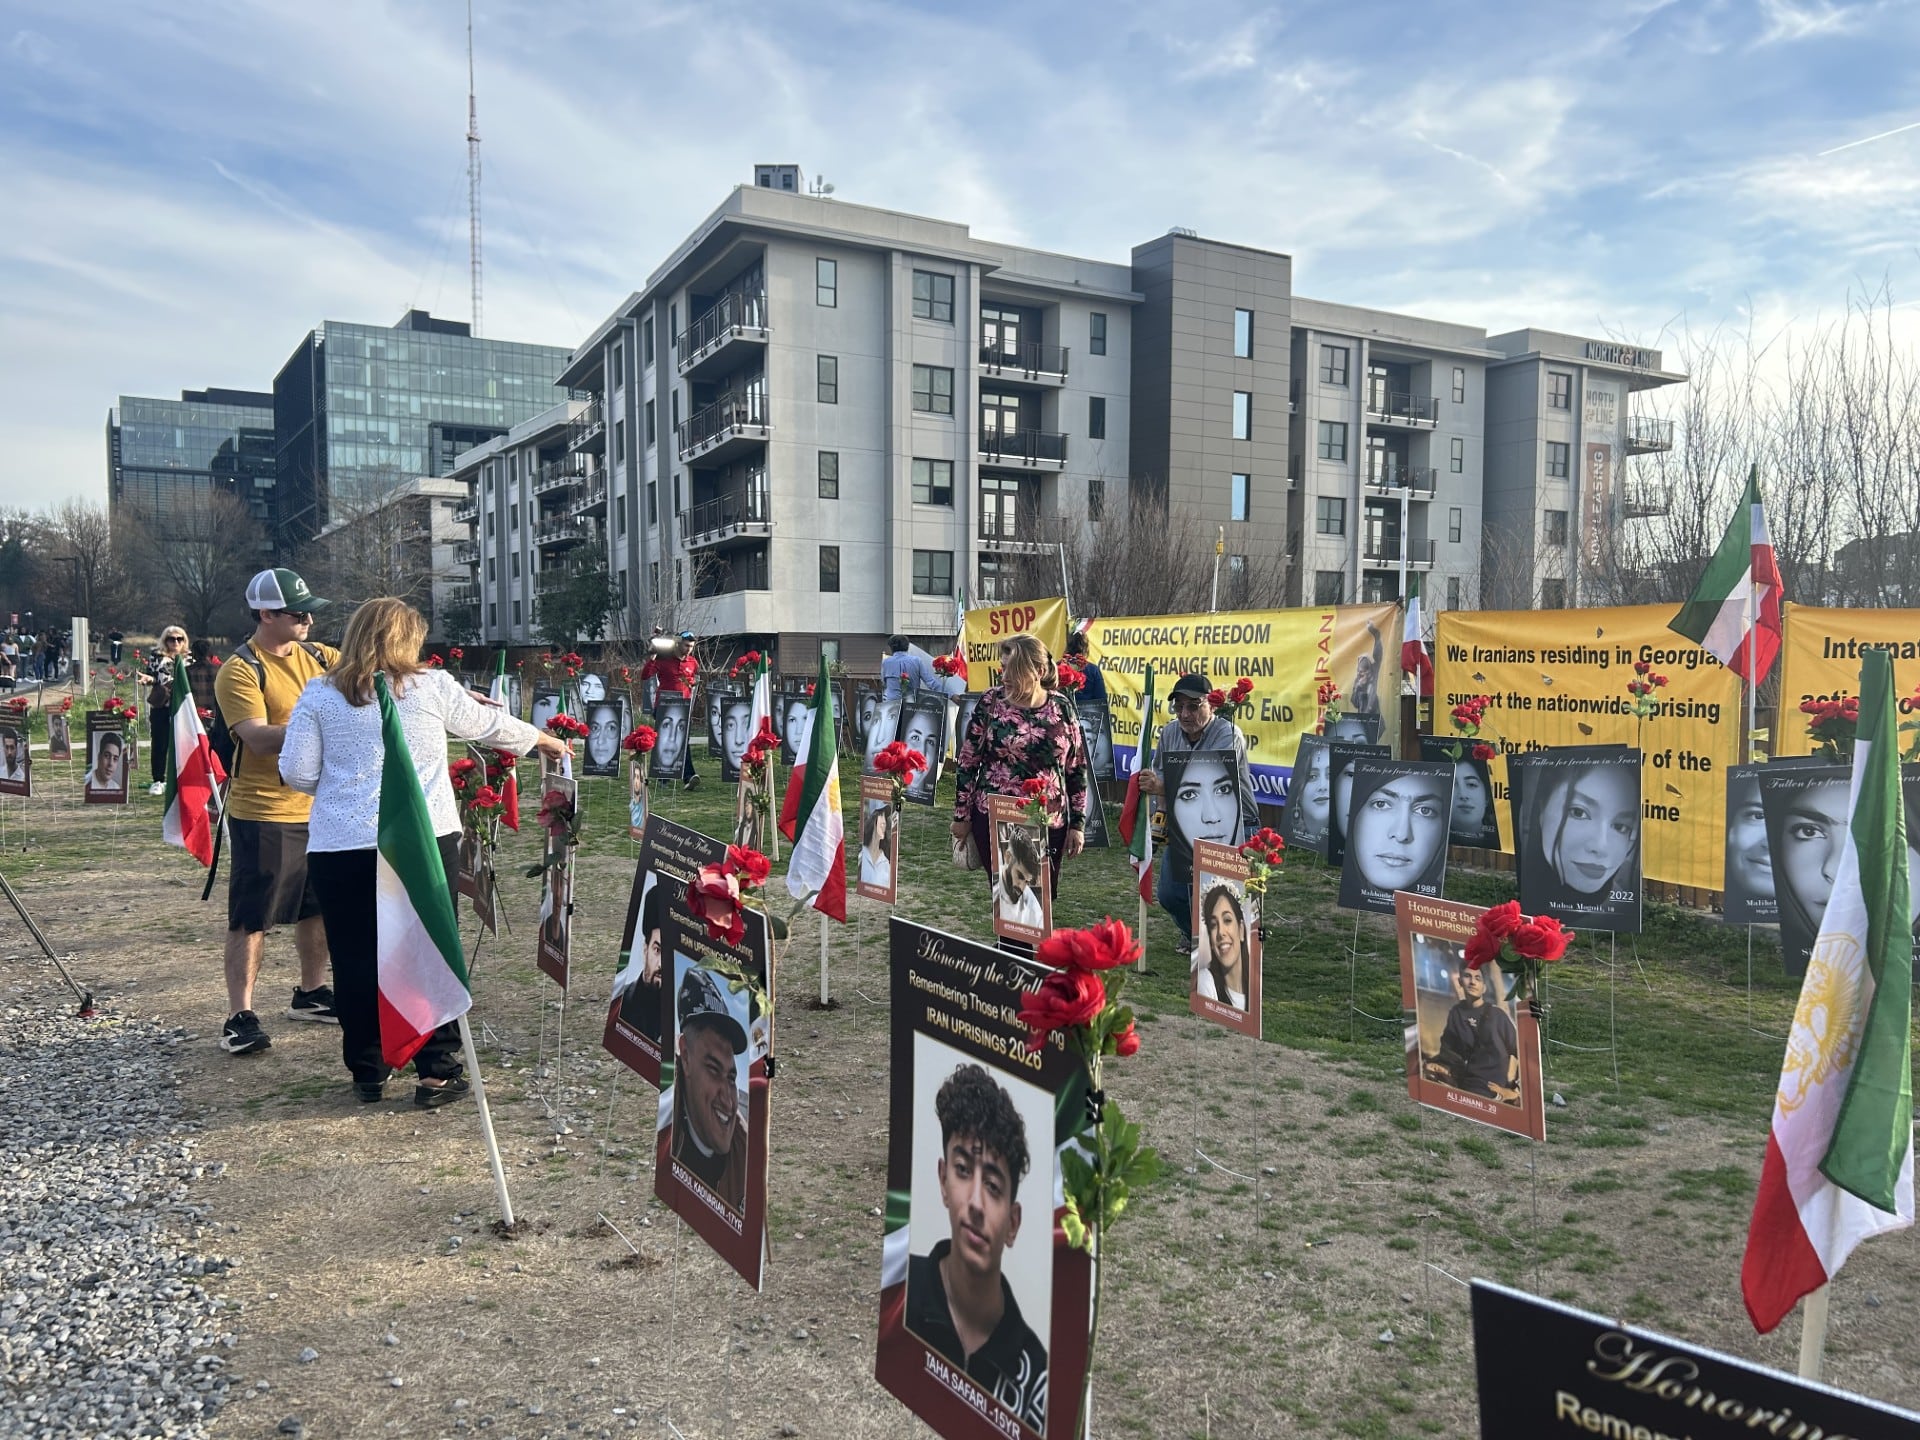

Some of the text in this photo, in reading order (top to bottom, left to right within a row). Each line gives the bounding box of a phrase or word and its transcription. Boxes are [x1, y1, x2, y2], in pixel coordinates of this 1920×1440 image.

[1588, 341, 1620, 364] NORTH
[1586, 389, 1614, 408] NORTH
[1595, 408, 1614, 425] LINE
[989, 606, 1036, 634] STOP
[1102, 623, 1271, 648] DEMOCRACY, FREEDOM
[1314, 614, 1335, 681] IRAN
[1447, 644, 1468, 662] We
[1473, 645, 1535, 663] Iranians
[1541, 643, 1609, 669] residing
[1616, 645, 1632, 664] in
[1153, 656, 1208, 676] CHANGE
[1213, 657, 1229, 676] IN
[1234, 656, 1274, 677] IRAN
[1261, 698, 1293, 722] END
[1507, 691, 1532, 710] the
[1537, 693, 1631, 714] nationwide
[1648, 697, 1720, 721] prising
[1500, 737, 1521, 753] for
[1527, 756, 1554, 767] Fallen
[1555, 758, 1567, 767] for
[1567, 756, 1600, 767] freedom
[1613, 753, 1637, 765] Iran
[1653, 751, 1671, 769] of
[1678, 751, 1712, 771] the
[1359, 765, 1380, 773] Fallen
[1381, 767, 1392, 775] for
[1430, 768, 1451, 777] Iran
[1732, 770, 1758, 779] Fallen
[1767, 777, 1804, 789] Fallen
[1806, 778, 1822, 789] for
[1200, 845, 1225, 860] Honoring
[1226, 850, 1234, 861] the
[1202, 856, 1212, 867] IRAN
[1416, 884, 1436, 894] 1988
[1610, 890, 1634, 901] 2022
[669, 907, 703, 936] Remembering
[1408, 900, 1477, 923] Honoring the
[1412, 914, 1433, 927] IRAN
[680, 933, 693, 950] IRAN
[917, 931, 1043, 996] Honoring the Fall
[909, 969, 968, 1010] Remembering
[969, 991, 999, 1018] Those
[926, 1006, 949, 1029] IRAN
[951, 1018, 1007, 1055] UPRISINGS
[672, 1162, 693, 1188] RASOUL
[925, 1350, 1021, 1440] TAHA SAFARI -15YR
